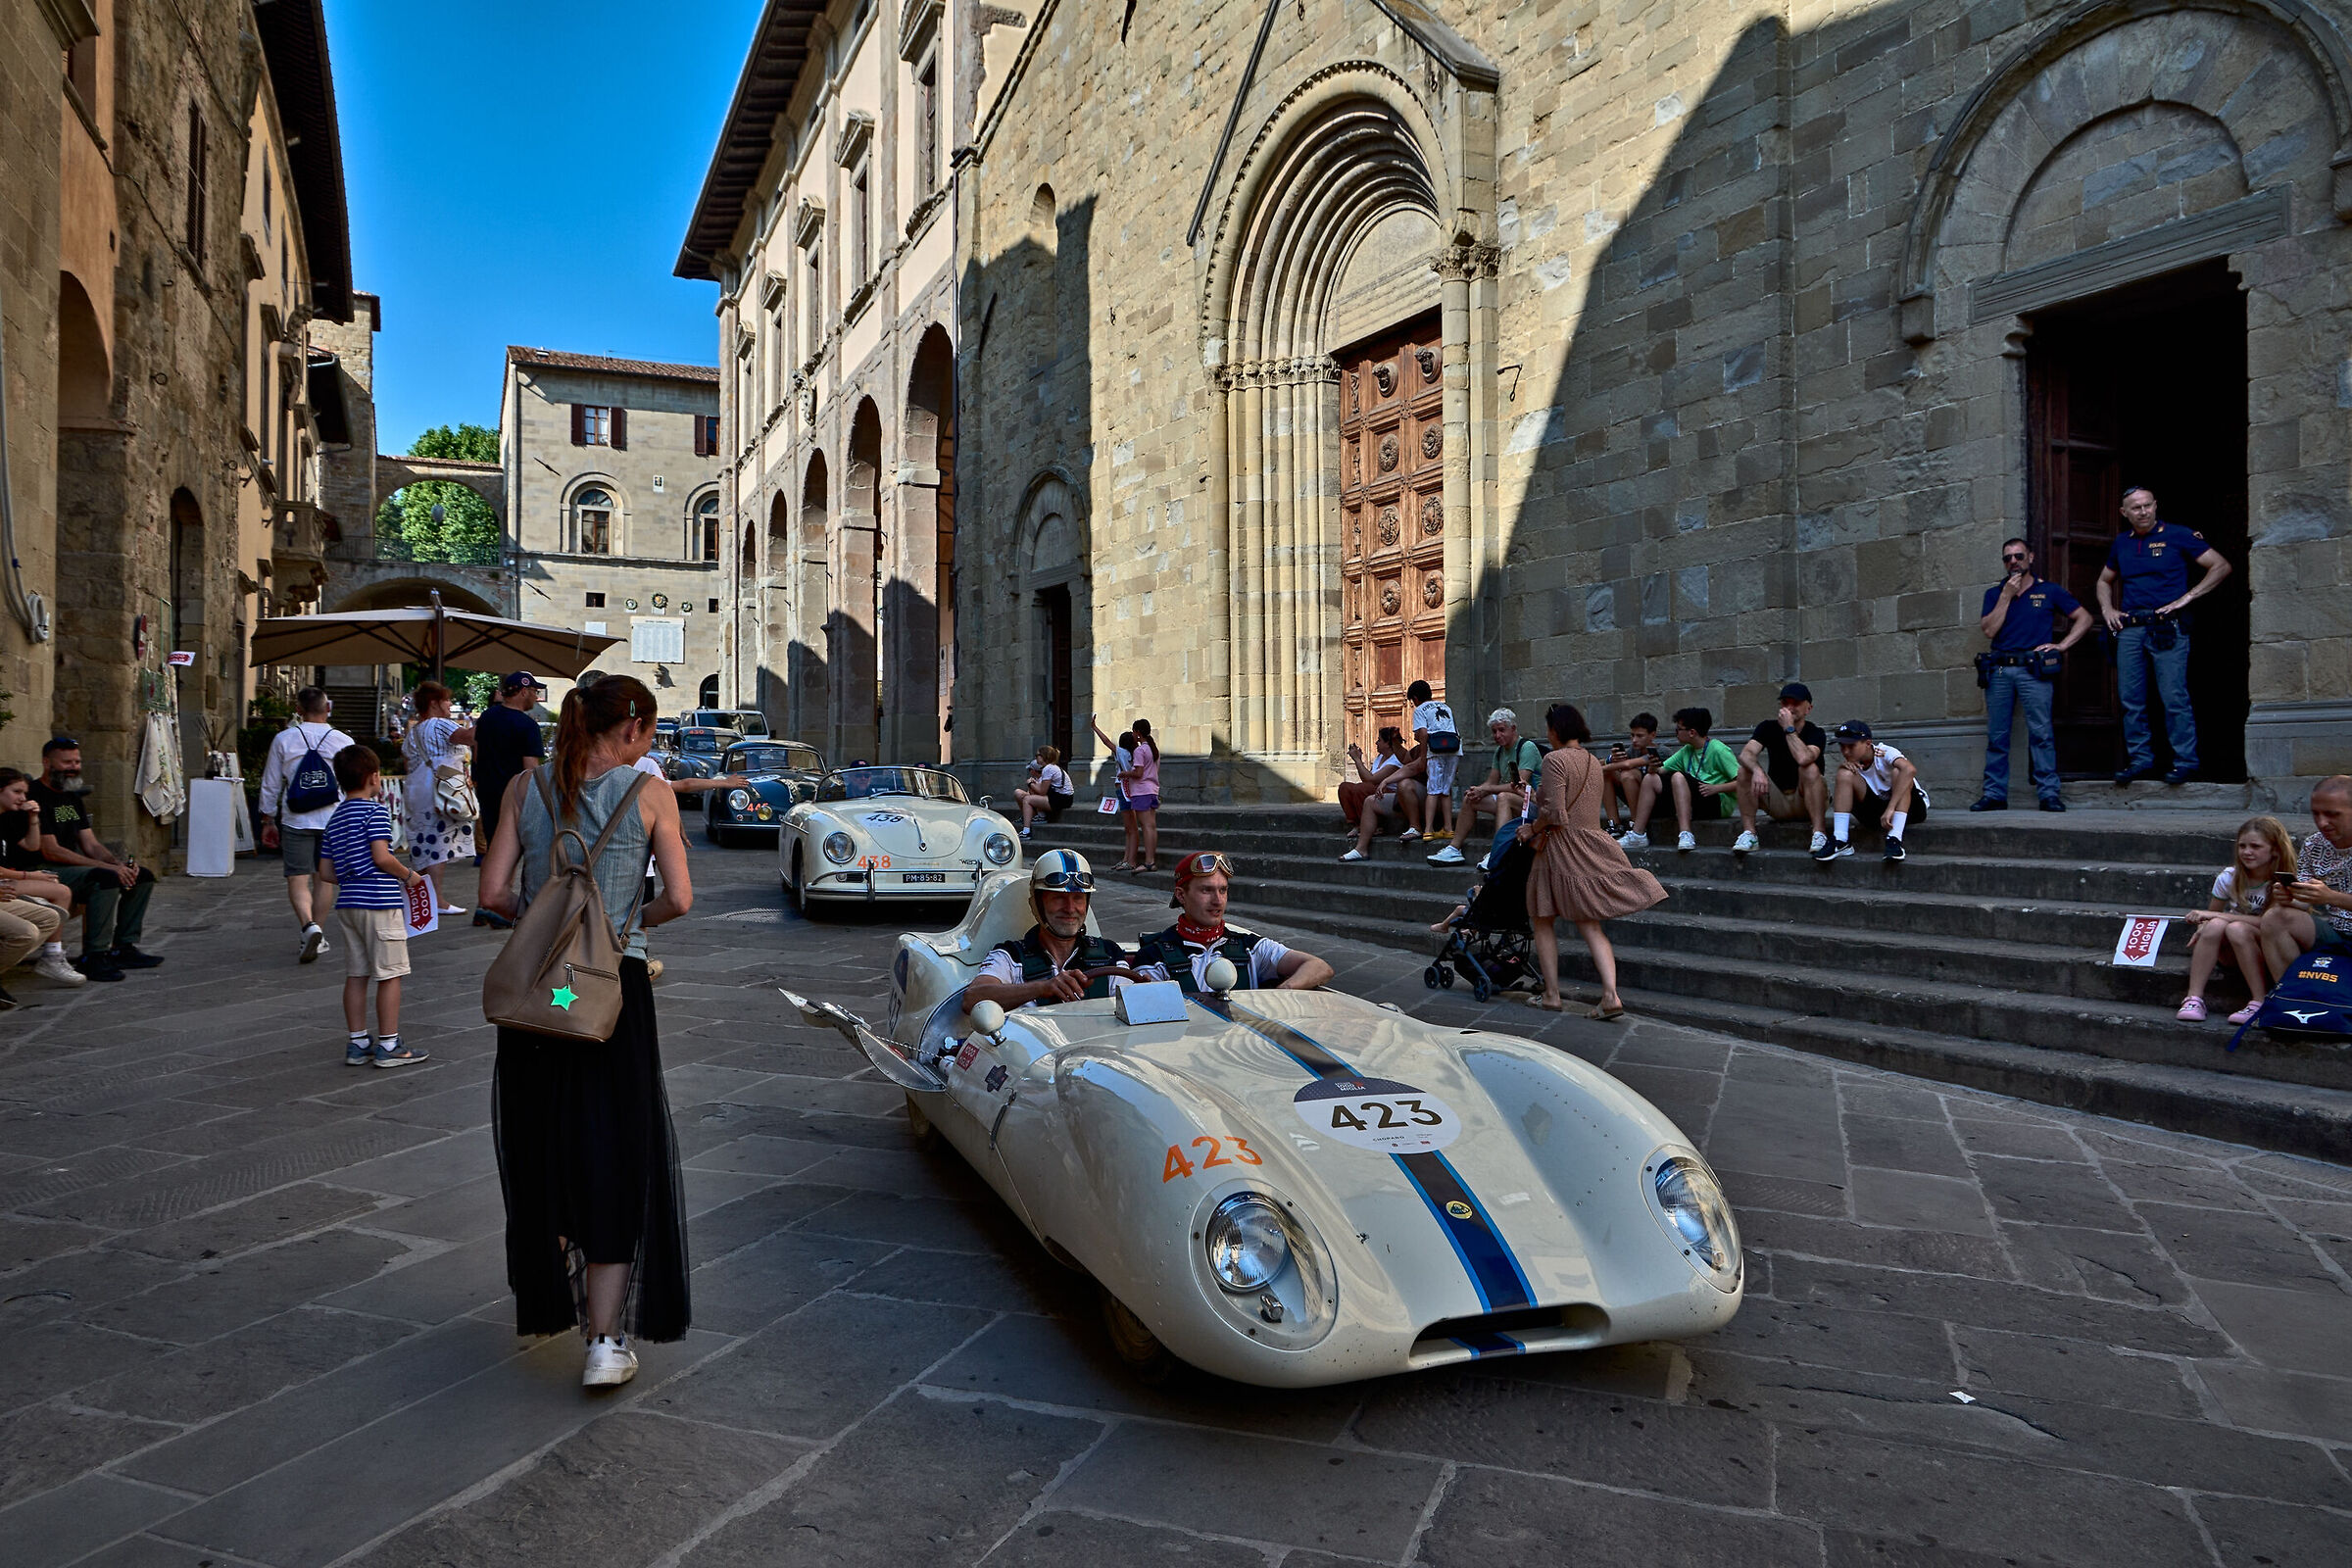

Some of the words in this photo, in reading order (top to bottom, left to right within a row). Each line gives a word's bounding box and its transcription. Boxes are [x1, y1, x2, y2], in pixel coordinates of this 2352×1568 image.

[866, 813, 904, 823] 438
[857, 855, 892, 869] 438
[2128, 922, 2145, 950] 1000
[2138, 920, 2158, 953] MIGLIA
[2298, 970, 2338, 983] #NVBS
[1331, 1100, 1443, 1131] 423
[1162, 1135, 1262, 1184] 423
